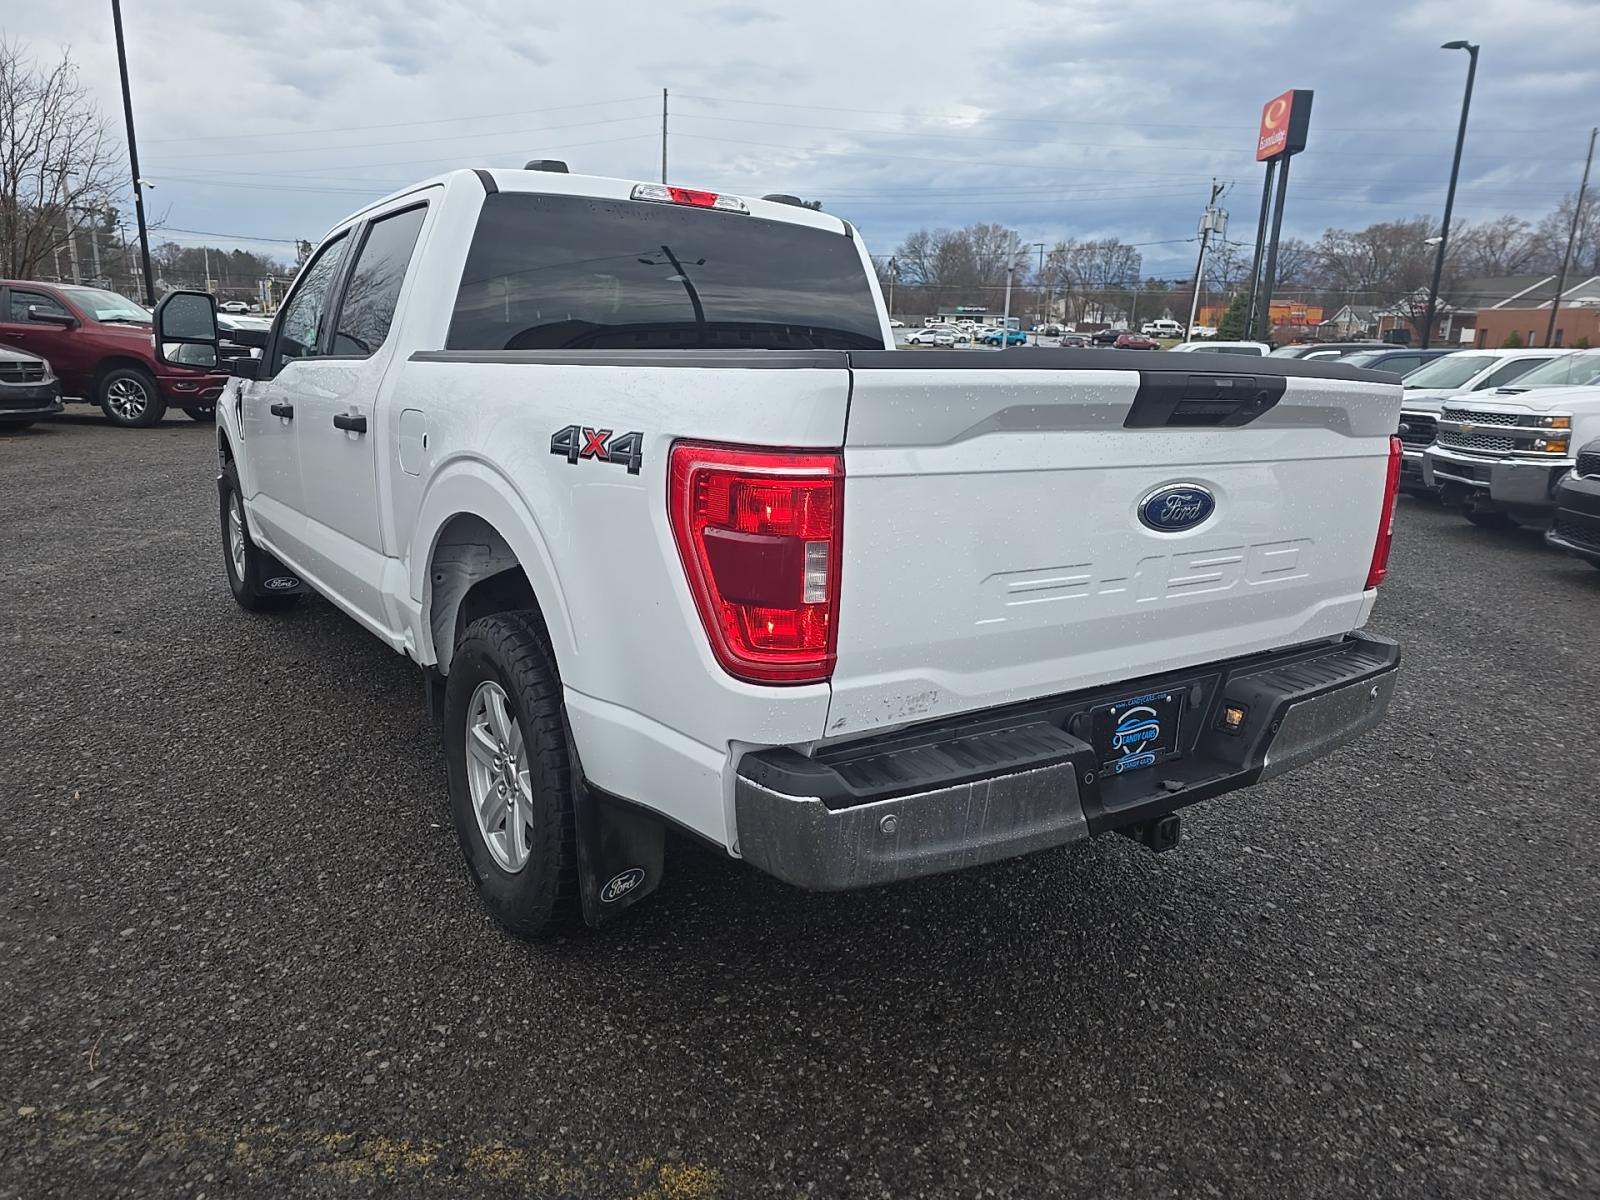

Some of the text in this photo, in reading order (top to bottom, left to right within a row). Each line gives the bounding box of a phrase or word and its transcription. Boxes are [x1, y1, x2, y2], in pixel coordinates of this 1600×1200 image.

[1122, 729, 1156, 745] CANDY CARS
[609, 874, 636, 898] Ford
